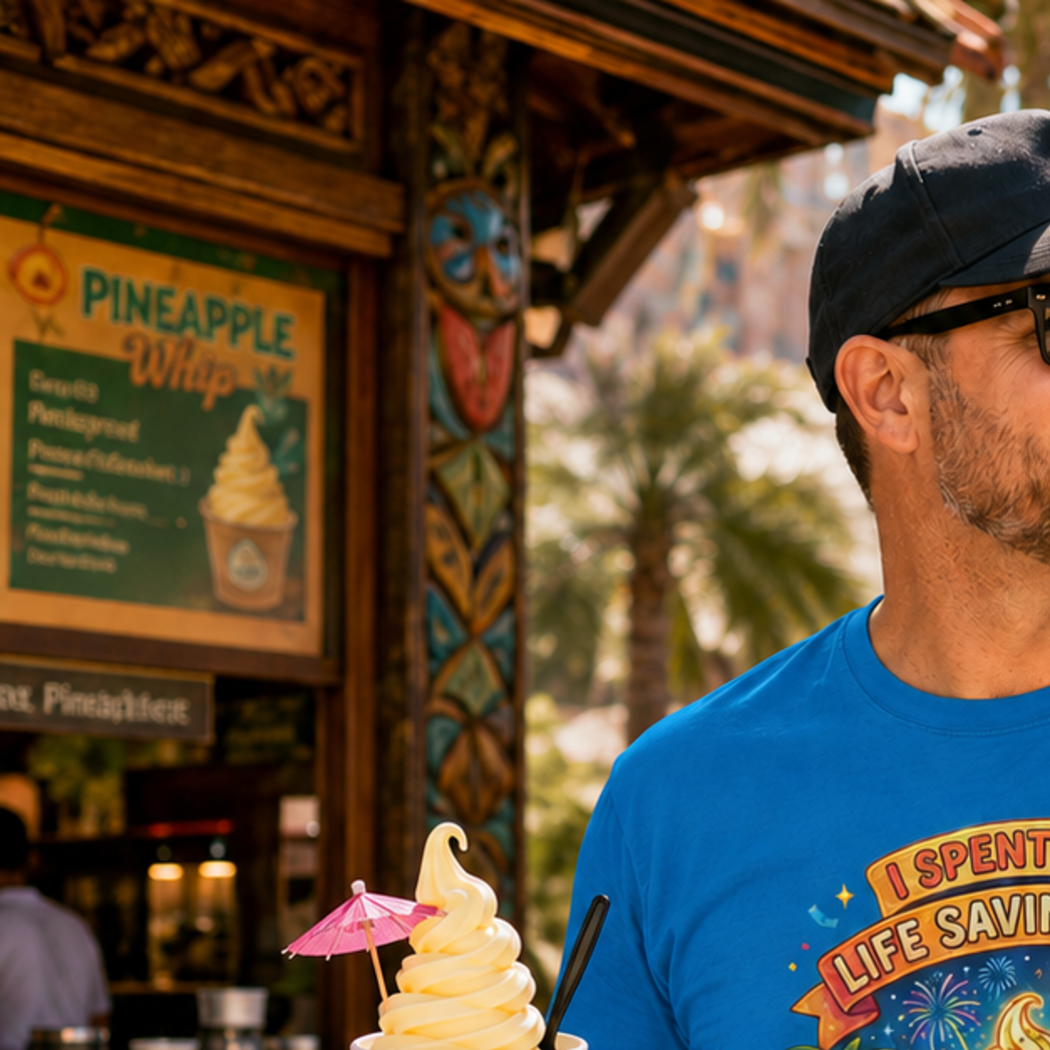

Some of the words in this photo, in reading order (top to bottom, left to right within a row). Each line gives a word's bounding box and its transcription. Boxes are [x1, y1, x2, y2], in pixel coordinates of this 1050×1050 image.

[80, 267, 296, 361] PINEAPPLE
[124, 333, 237, 411] Whip
[885, 861, 910, 900] I
[832, 918, 929, 995] LIFE
